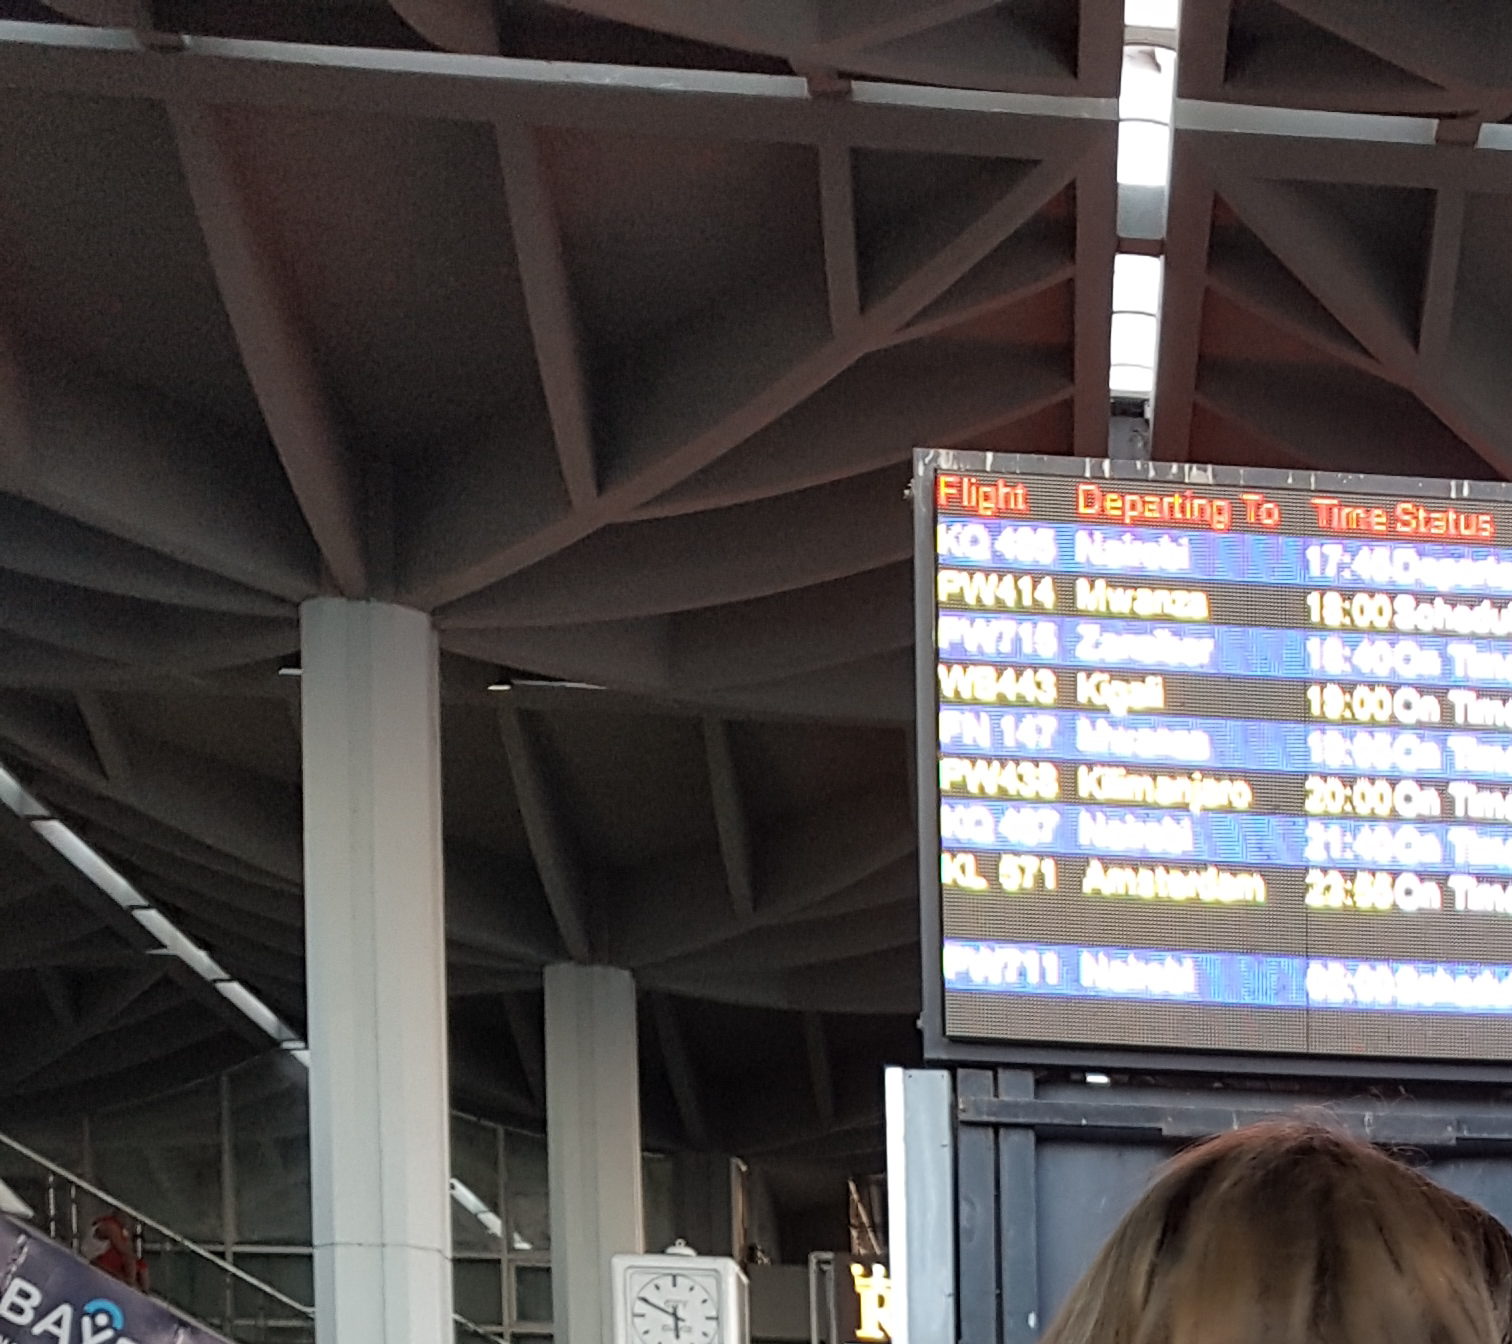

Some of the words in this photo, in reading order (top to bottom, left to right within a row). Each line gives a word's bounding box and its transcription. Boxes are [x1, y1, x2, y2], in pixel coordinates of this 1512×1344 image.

[938, 476, 1028, 516] Flight
[1077, 484, 1231, 530] Departing
[1242, 494, 1280, 525] To
[1311, 498, 1388, 535] Time
[1395, 503, 1494, 538] Status
[939, 571, 1052, 607] PW414
[1077, 579, 1205, 616] Mwanza
[1393, 641, 1440, 678] On
[1394, 688, 1440, 723] On
[1393, 734, 1440, 771] On
[1079, 767, 1251, 814] Kilimanjaro
[1305, 776, 1391, 813] 20:00
[1395, 780, 1440, 817] On
[1394, 825, 1441, 864] On
[999, 855, 1056, 890] 571
[1083, 859, 1265, 901] Amsterdam
[1395, 873, 1441, 911] On
